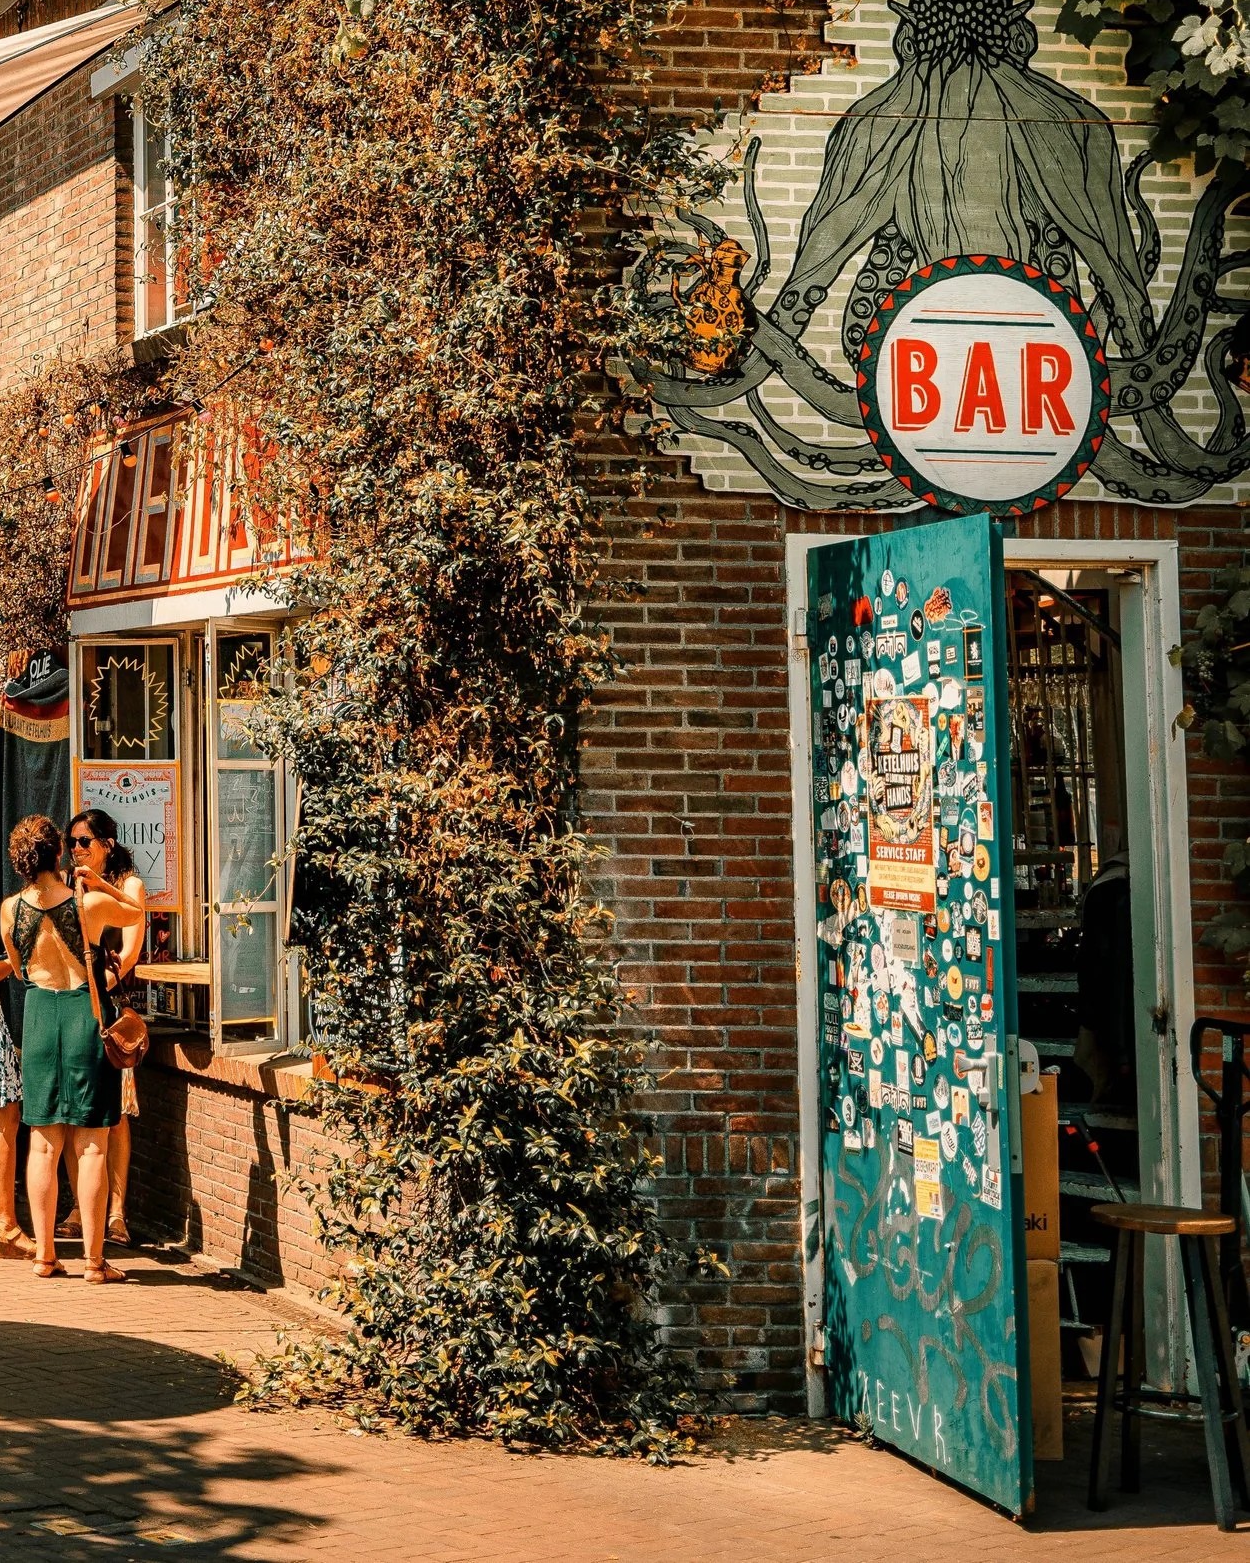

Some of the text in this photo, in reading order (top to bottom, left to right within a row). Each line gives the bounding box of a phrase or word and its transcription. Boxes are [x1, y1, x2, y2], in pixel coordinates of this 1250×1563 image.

[890, 338, 1076, 436] BAR
[878, 753, 919, 774] KETELHUIS
[98, 788, 157, 804] KETELHUIS
[886, 786, 911, 807] HANDS
[876, 845, 926, 862] SERVICE STAFF
